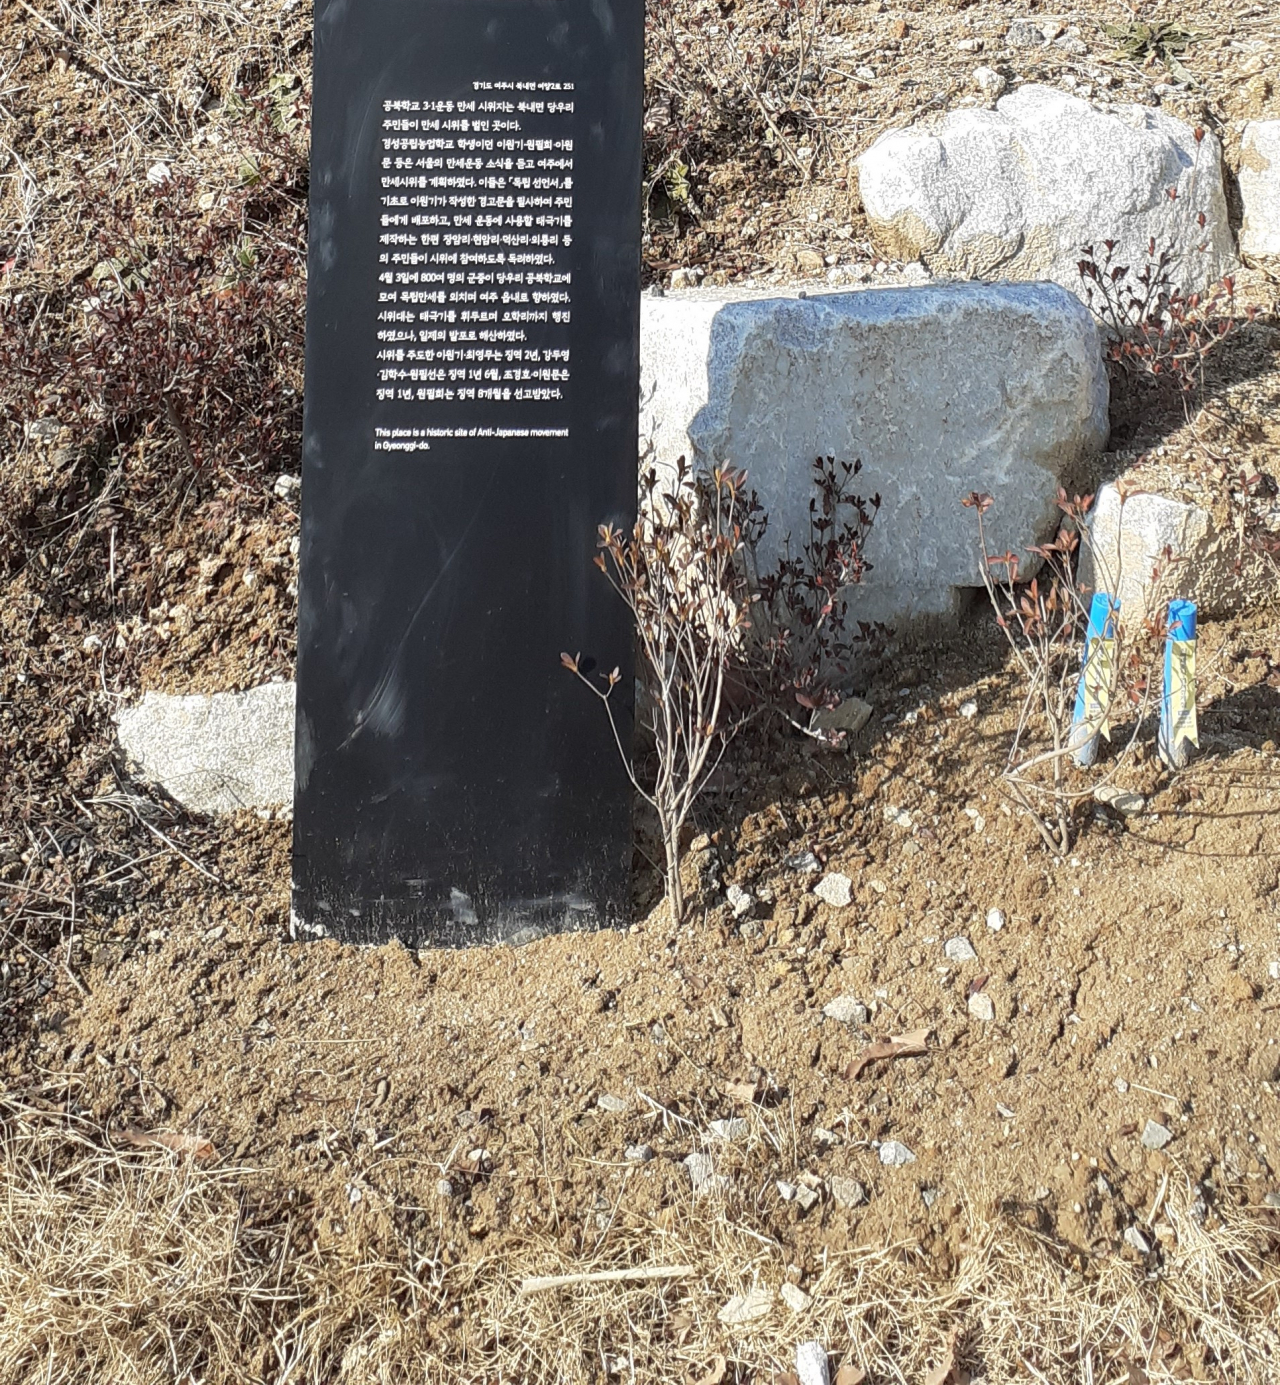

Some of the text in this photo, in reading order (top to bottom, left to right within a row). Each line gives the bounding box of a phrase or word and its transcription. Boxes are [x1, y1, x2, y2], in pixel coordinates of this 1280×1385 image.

[473, 81, 492, 90] 경기도
[494, 82, 514, 90] 여주시
[516, 82, 536, 90] 북내면
[383, 100, 420, 111] 공북학교
[457, 101, 475, 112] 만세
[478, 101, 515, 112] 시위지는
[517, 102, 544, 113] 북내면
[547, 102, 573, 113] 당우리
[382, 119, 418, 130] 주민들이
[421, 119, 439, 130] 만세
[442, 119, 470, 131] 시위를
[492, 120, 521, 131] 곳이다.
[382, 138, 454, 150] 경성공립농업학교
[457, 139, 493, 150] 학생이던
[381, 157, 573, 169] 문 등은 서울의 만세운동 소식을 듣고 여주에서
[380, 176, 427, 188] 만세시위를
[428, 176, 478, 188] 계획하였다.
[478, 177, 507, 188] 이들은
[381, 195, 409, 206] 기초로
[410, 195, 447, 207] 이원기가
[449, 196, 476, 207] 작성한
[517, 196, 552, 207] 필사하여
[554, 197, 572, 207] 주민
[380, 214, 572, 227] 들에게 배포하고, 만세 운동에 사용할 태극기를
[379, 234, 417, 245] 제작하는
[421, 234, 439, 245] 한편
[562, 235, 572, 246] 등
[379, 253, 388, 264] 의
[391, 253, 427, 264] 주민들이
[430, 253, 457, 264] 시위에
[460, 253, 506, 265] 참여하도록
[379, 272, 571, 284] 4월 3일에 800여 명의 군중이 당우리 공북학교에
[378, 291, 570, 303] 모여 독립만세를 외치며 여주 읍내로 향하였다.
[378, 310, 570, 323] 시위대는 태극기를 휘두르며 오학리까지 행진
[377, 330, 527, 342] 하였으나, 일제의 발포로 해산하였다.
[377, 349, 405, 361] 시위를
[406, 349, 435, 361] 주도한
[505, 349, 522, 361] 징역
[448, 368, 465, 380] 징역
[469, 368, 482, 380] 1년
[376, 388, 394, 400] 징역
[457, 388, 475, 400] 징역
[514, 388, 562, 399] 선고받았다.
[375, 427, 569, 439] This place is a historic site of Anti-Japanese movement
[374, 441, 430, 453] in Gyeonggi-do.
